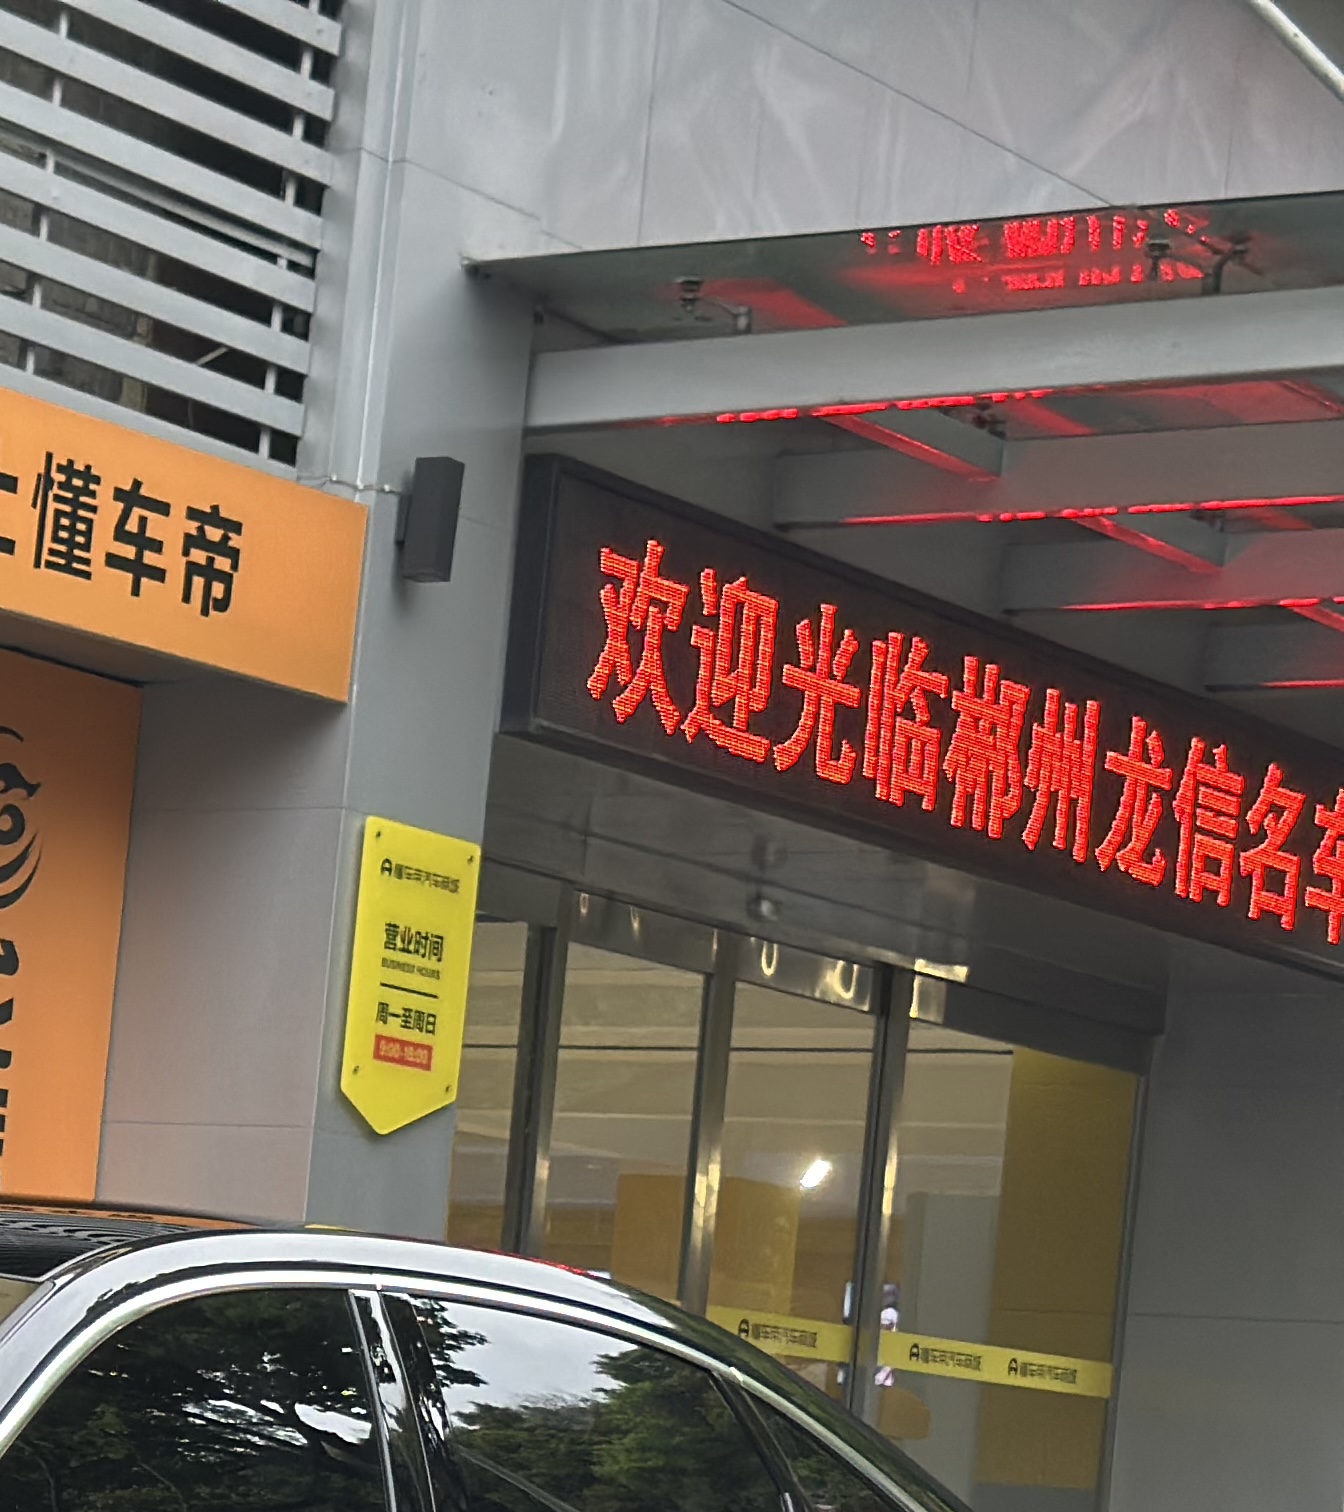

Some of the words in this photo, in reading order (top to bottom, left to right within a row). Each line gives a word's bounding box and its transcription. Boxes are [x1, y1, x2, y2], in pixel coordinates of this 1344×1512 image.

[383, 922, 444, 962] 营业时间
[375, 1001, 437, 1036] 周一至周日
